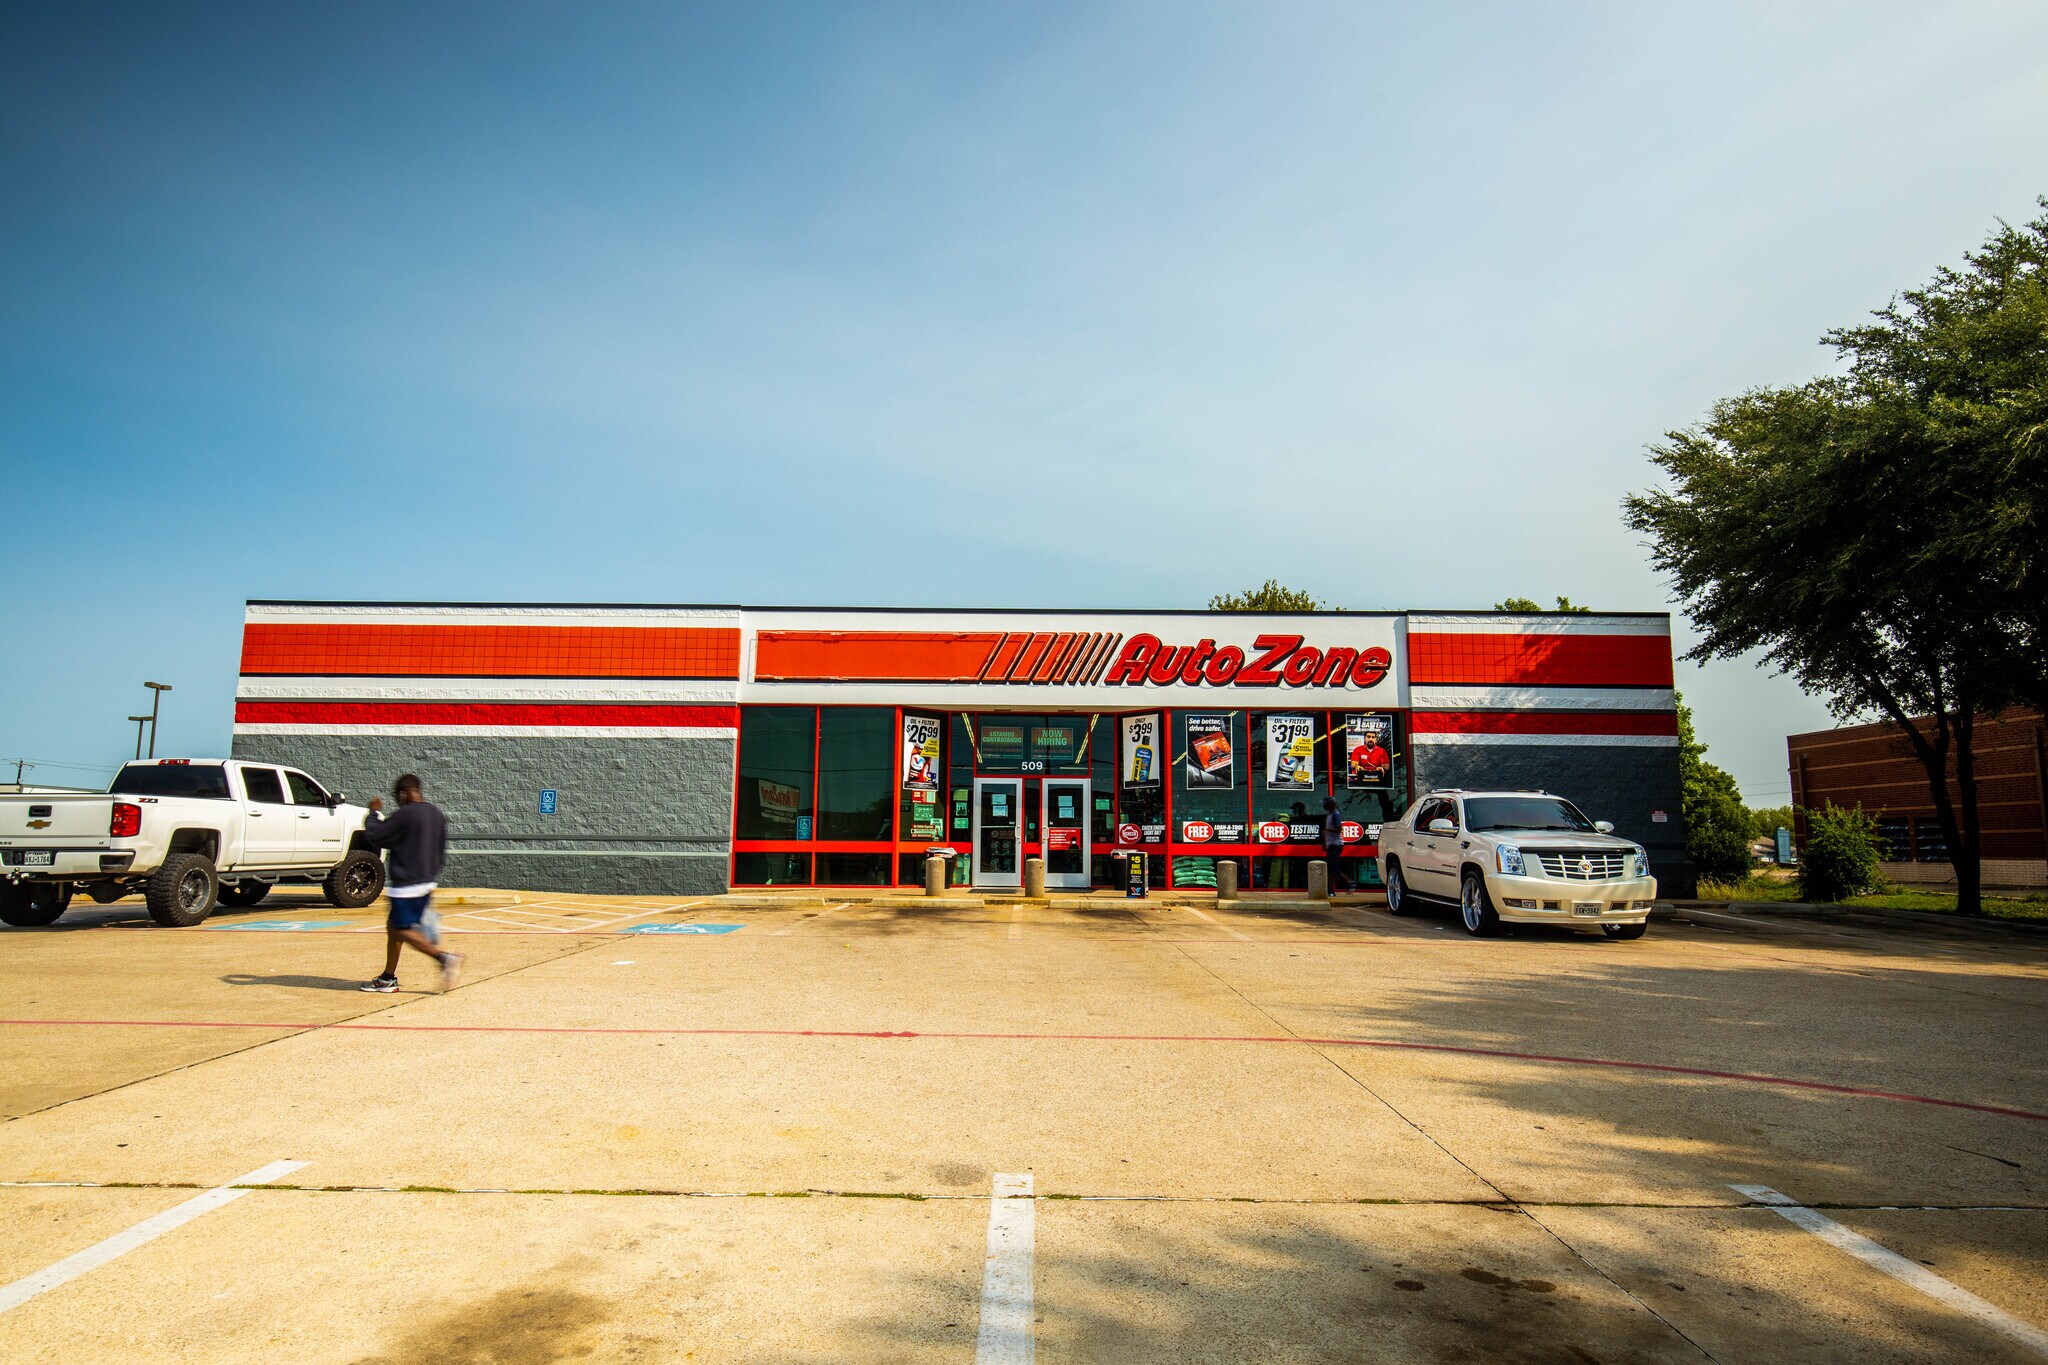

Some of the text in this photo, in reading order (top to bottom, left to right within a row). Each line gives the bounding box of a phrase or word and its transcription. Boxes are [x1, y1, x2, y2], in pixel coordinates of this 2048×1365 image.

[1104, 633, 1392, 688] AutoZone
[1042, 730, 1063, 738] NOW
[1021, 761, 1043, 770] 509
[1188, 826, 1209, 838] FREE
[1264, 826, 1285, 838] FREE
[1290, 825, 1320, 834] TESTING
